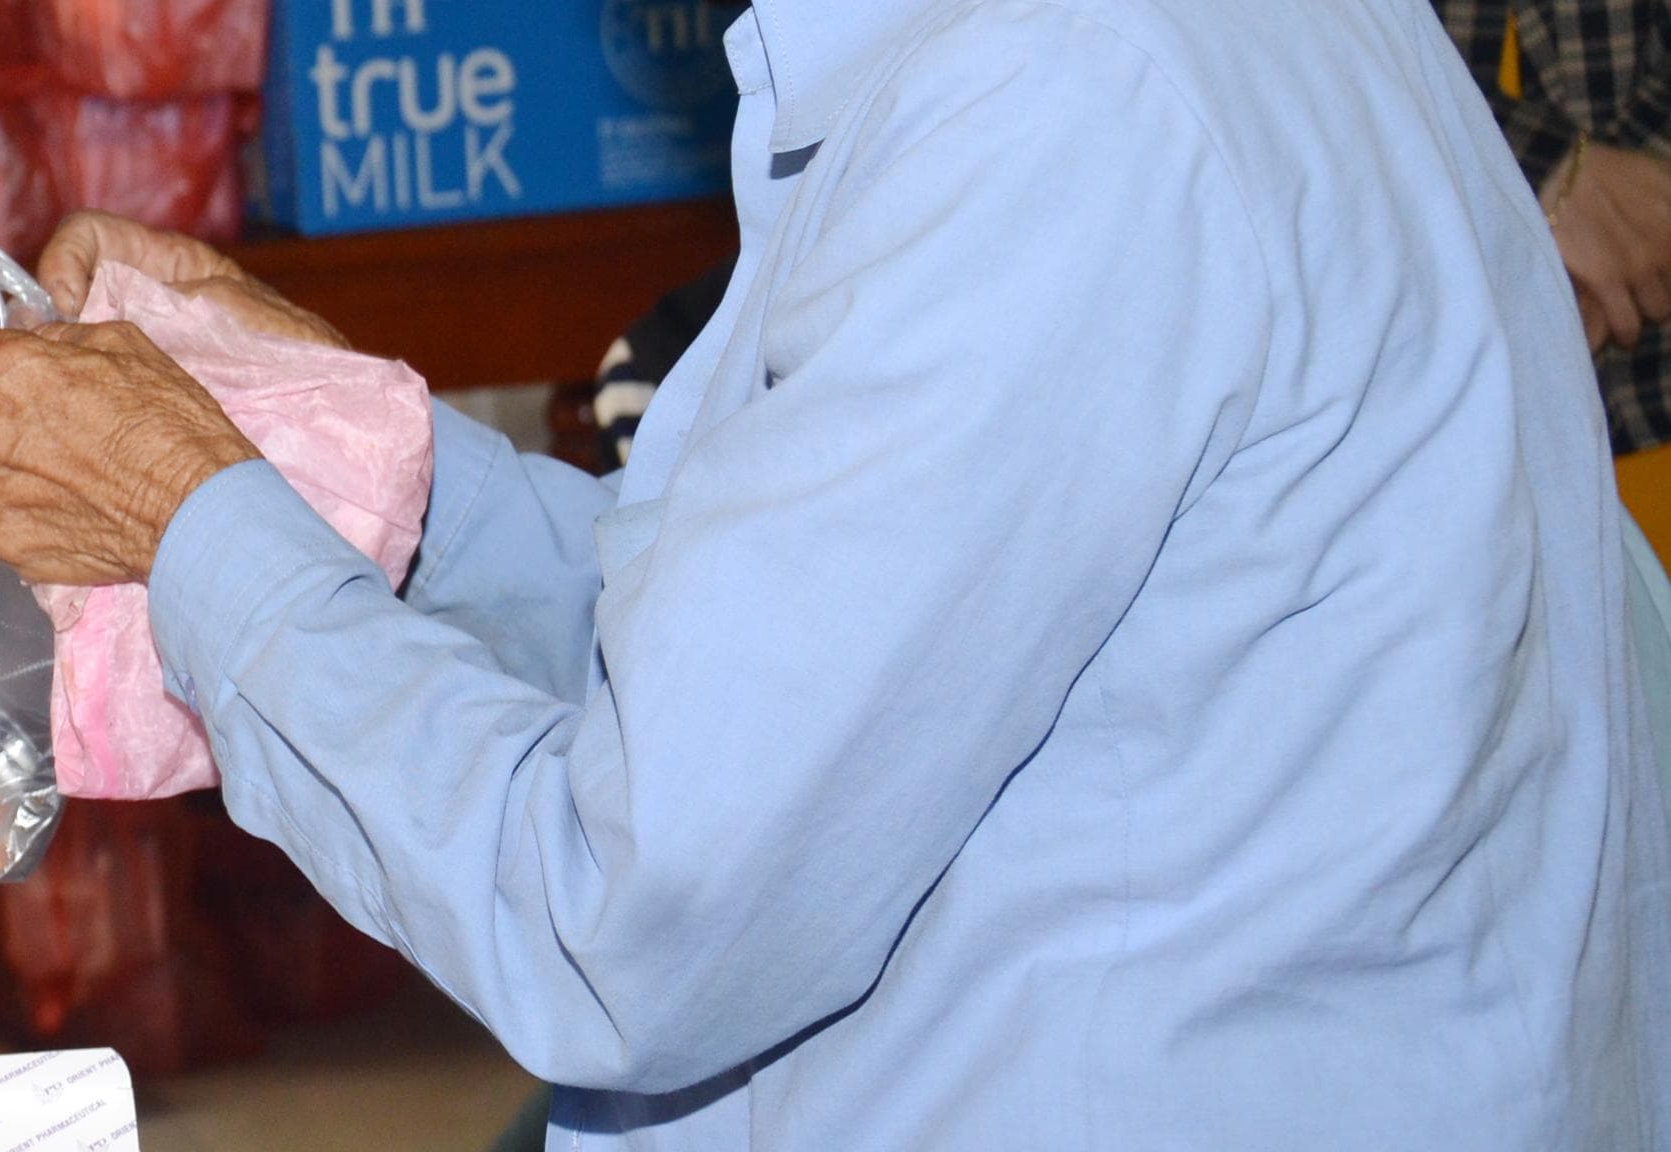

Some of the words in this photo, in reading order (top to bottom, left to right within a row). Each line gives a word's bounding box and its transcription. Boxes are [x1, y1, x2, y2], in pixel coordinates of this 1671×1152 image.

[310, 44, 517, 140] true
[321, 116, 524, 217] MILK
[66, 1064, 97, 1084] ORIENT
[36, 1098, 107, 1143] PHARMACEUTICAL
